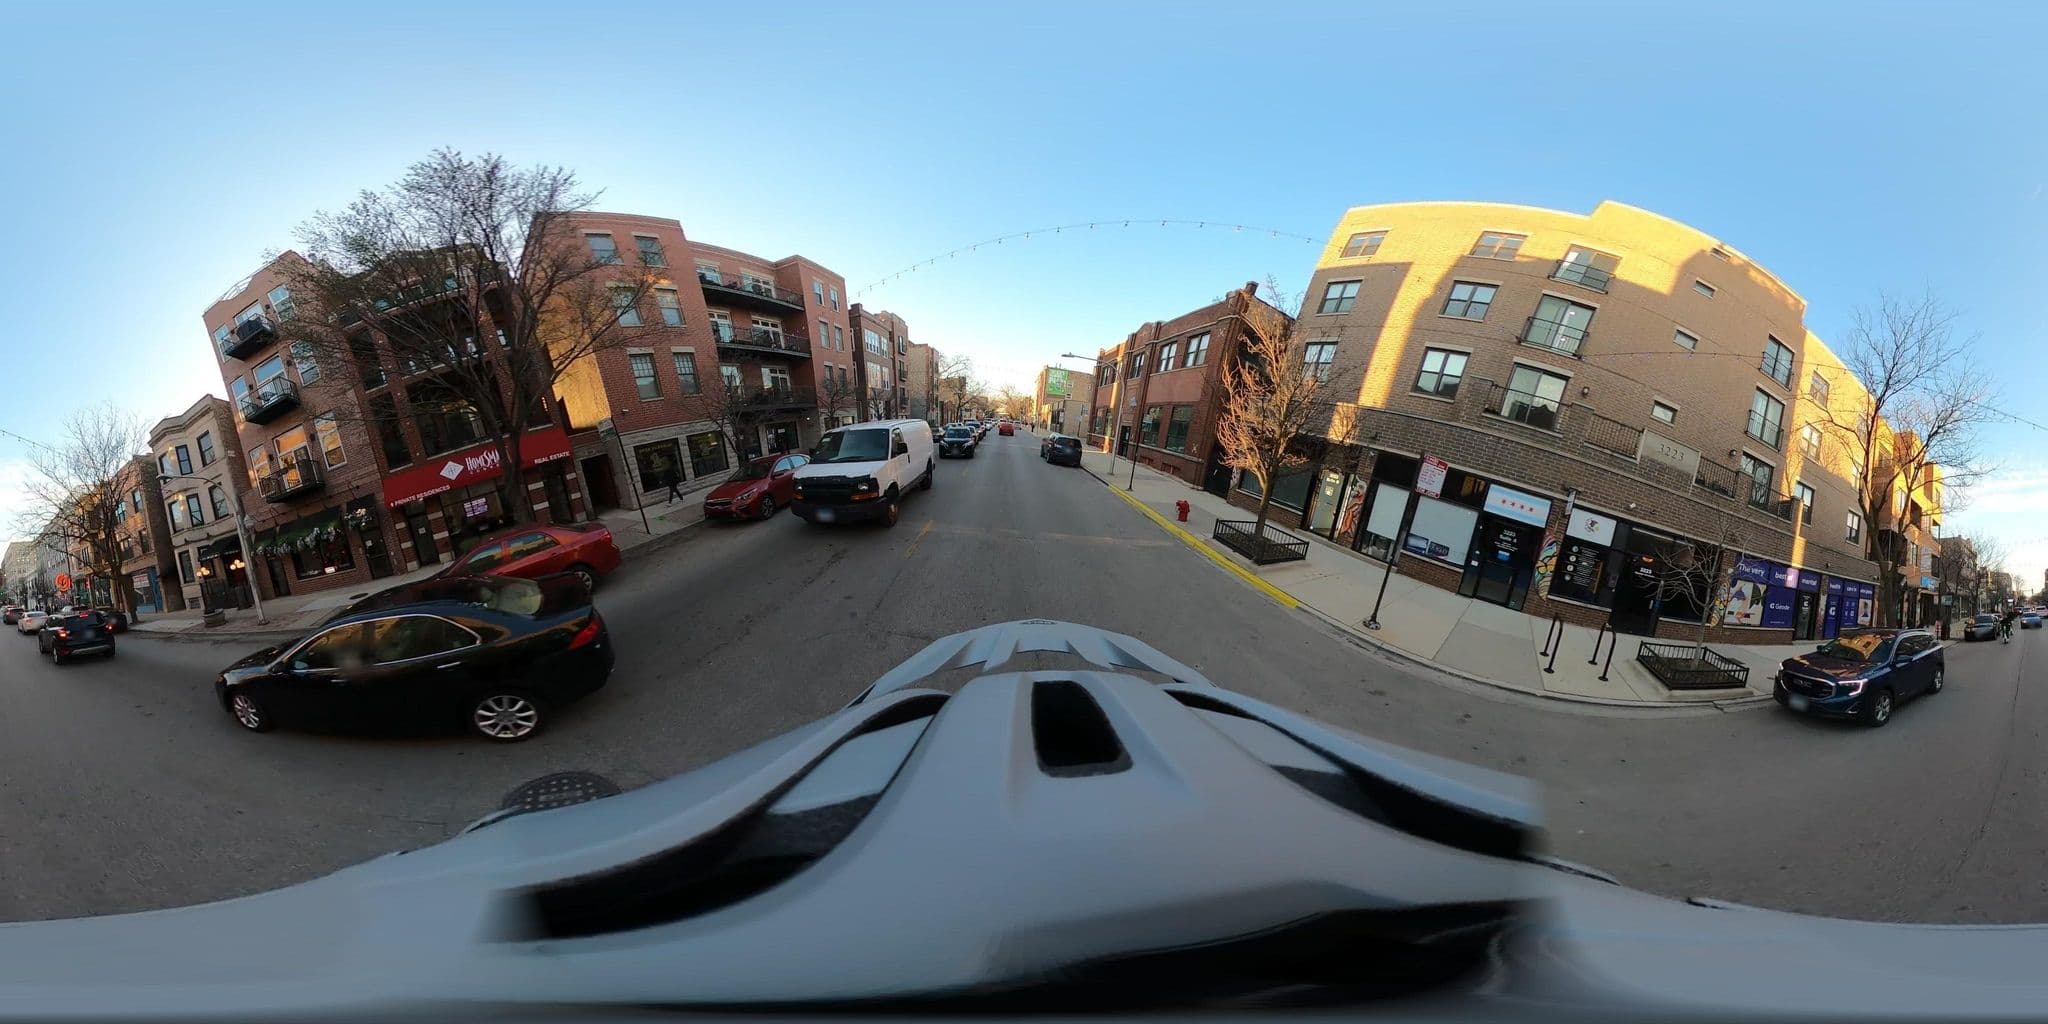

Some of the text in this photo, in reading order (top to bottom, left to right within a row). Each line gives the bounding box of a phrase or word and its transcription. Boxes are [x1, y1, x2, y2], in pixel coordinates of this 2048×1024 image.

[550, 451, 570, 461] ESTATE
[1660, 443, 1684, 460] 3223
[416, 484, 451, 500] RESIDENCES
[1751, 567, 1765, 577] very
[1775, 572, 1787, 580] best
